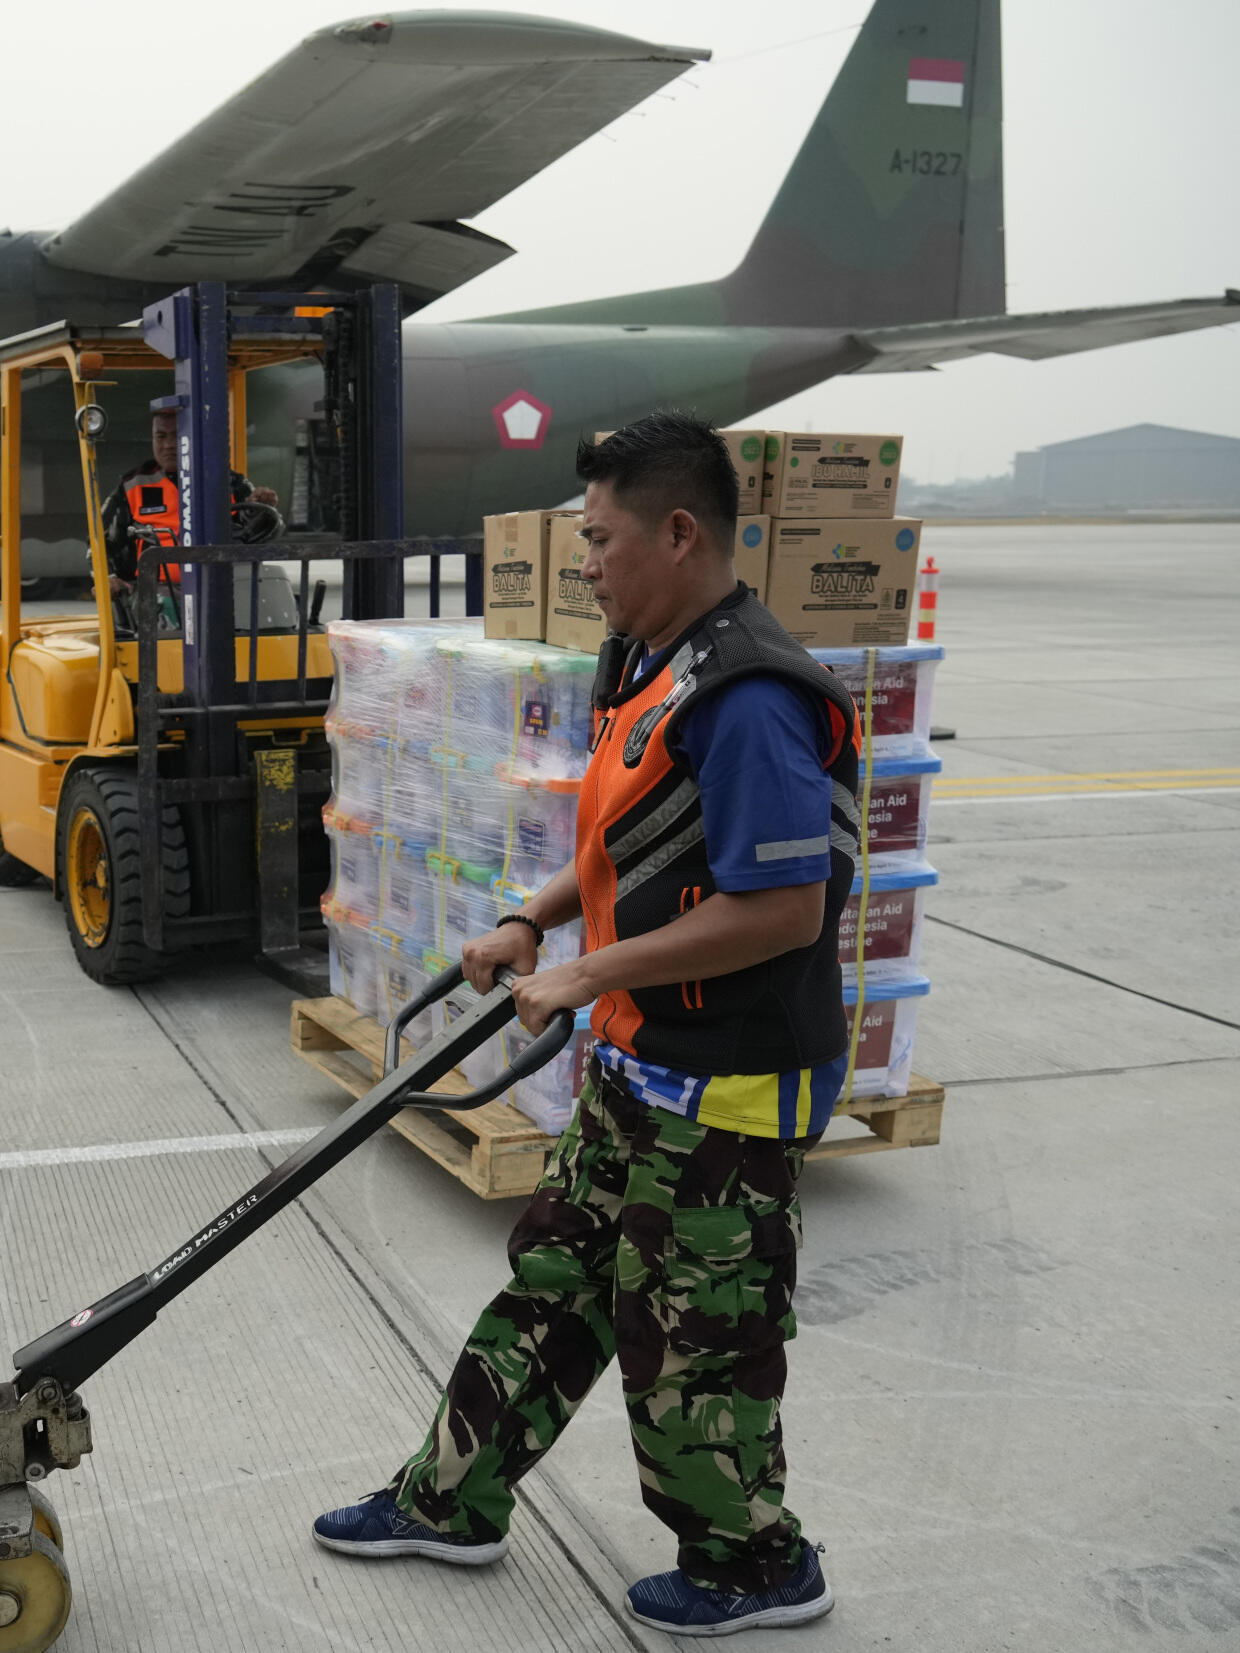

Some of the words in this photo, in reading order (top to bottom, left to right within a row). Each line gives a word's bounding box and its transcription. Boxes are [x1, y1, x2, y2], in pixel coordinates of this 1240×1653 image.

[889, 149, 963, 176] A-1327
[492, 573, 531, 593] BALITA
[810, 574, 875, 594] BALITA
[884, 676, 904, 689] Aid
[887, 794, 907, 807] Aid
[882, 903, 903, 916] Aid
[862, 1015, 882, 1028] Aid
[153, 1246, 193, 1279] LOAD
[195, 1194, 258, 1248] MASTER
